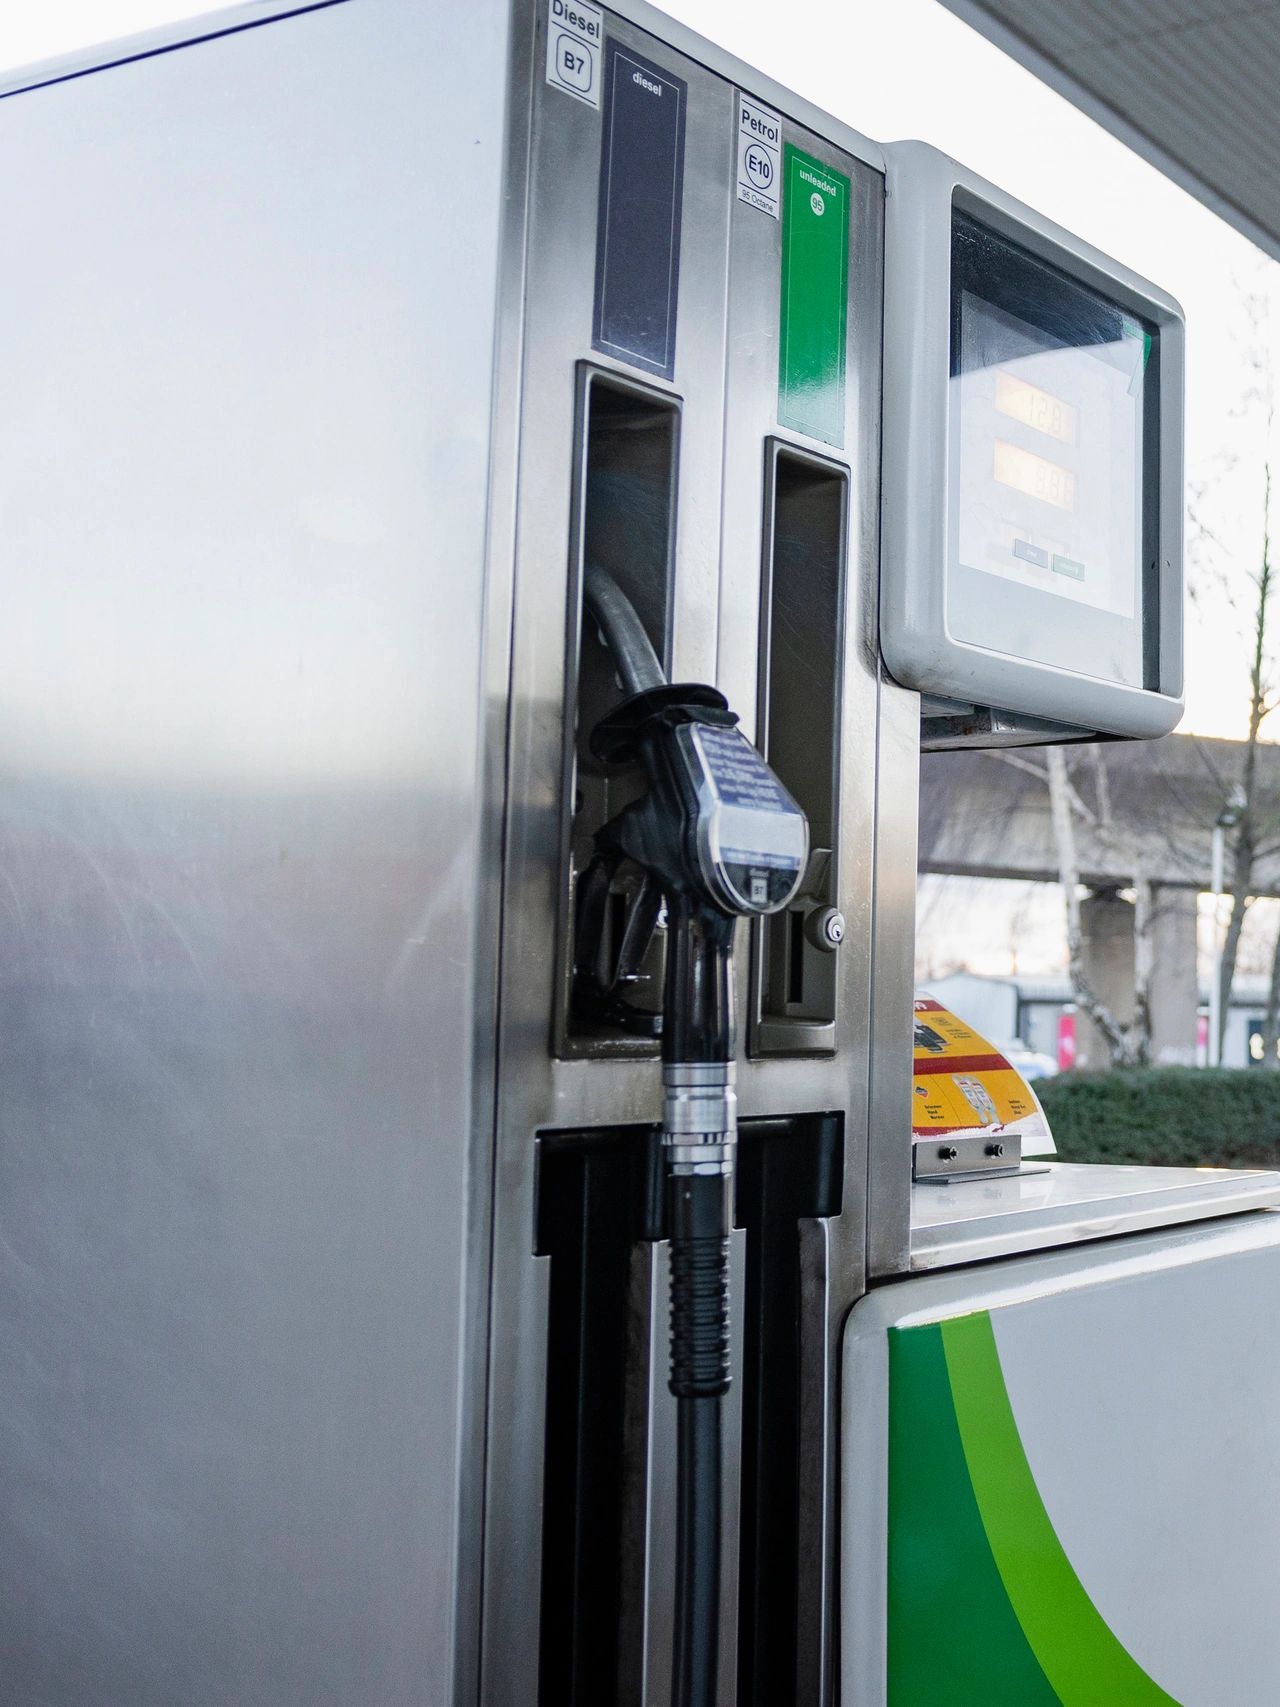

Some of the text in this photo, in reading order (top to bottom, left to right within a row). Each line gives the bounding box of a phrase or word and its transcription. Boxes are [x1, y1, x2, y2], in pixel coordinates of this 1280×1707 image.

[552, 0, 600, 39] Diesel
[564, 51, 585, 75] B7
[632, 71, 662, 97] diesel
[742, 109, 779, 143] Petrol
[748, 154, 770, 179] E10
[799, 169, 837, 197] unleaded
[742, 189, 774, 213] 95 Octane
[812, 197, 823, 212] 95
